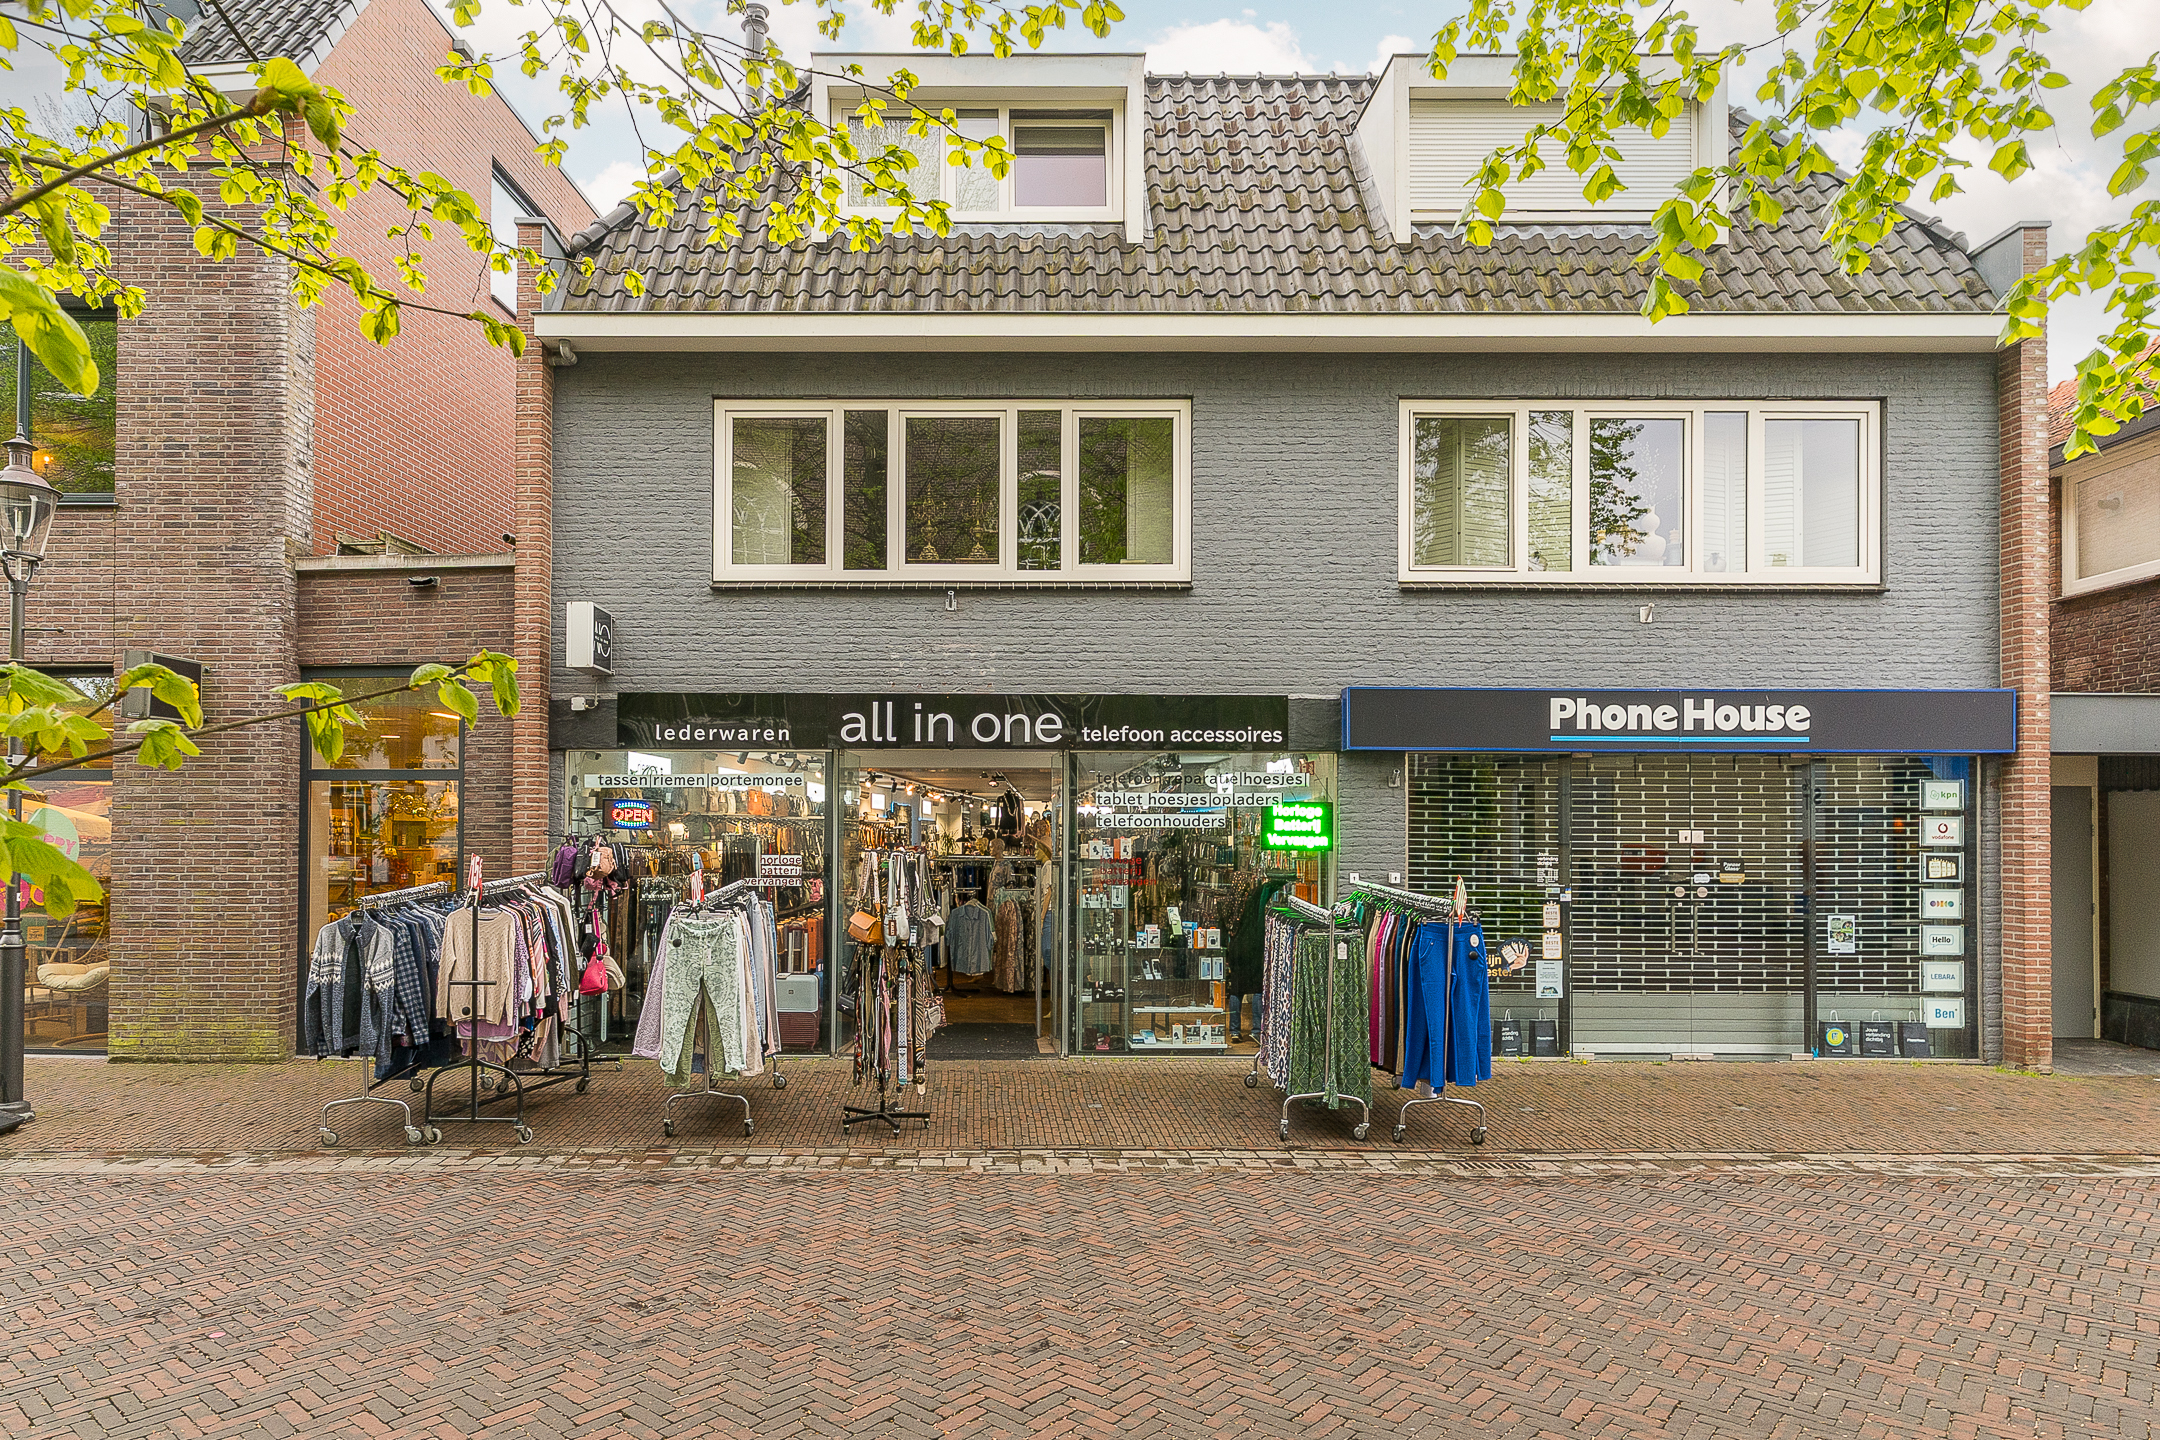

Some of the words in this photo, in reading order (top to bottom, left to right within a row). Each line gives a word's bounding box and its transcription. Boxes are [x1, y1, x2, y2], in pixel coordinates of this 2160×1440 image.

[1550, 697, 1811, 731] PhoneHouse
[840, 701, 897, 743] all
[914, 702, 954, 742] in
[971, 712, 1063, 743] one
[655, 724, 790, 741] lederwaren
[1081, 725, 1164, 742] telefoon
[1170, 726, 1283, 743] accessoires
[1096, 772, 1162, 784] telefoon
[1168, 772, 1238, 787] reparatie
[1096, 792, 1143, 805] tablet
[1940, 791, 1957, 799] kpn
[611, 808, 654, 823] OPEN
[1272, 804, 1323, 819] Horloge
[1096, 814, 1225, 827] telefoonhouders
[1100, 856, 1142, 865] horloge
[1100, 866, 1142, 876] batterij
[1100, 878, 1157, 887] vervangen
[1487, 968, 1512, 977] este!
[1935, 1008, 1955, 1019] Ben
